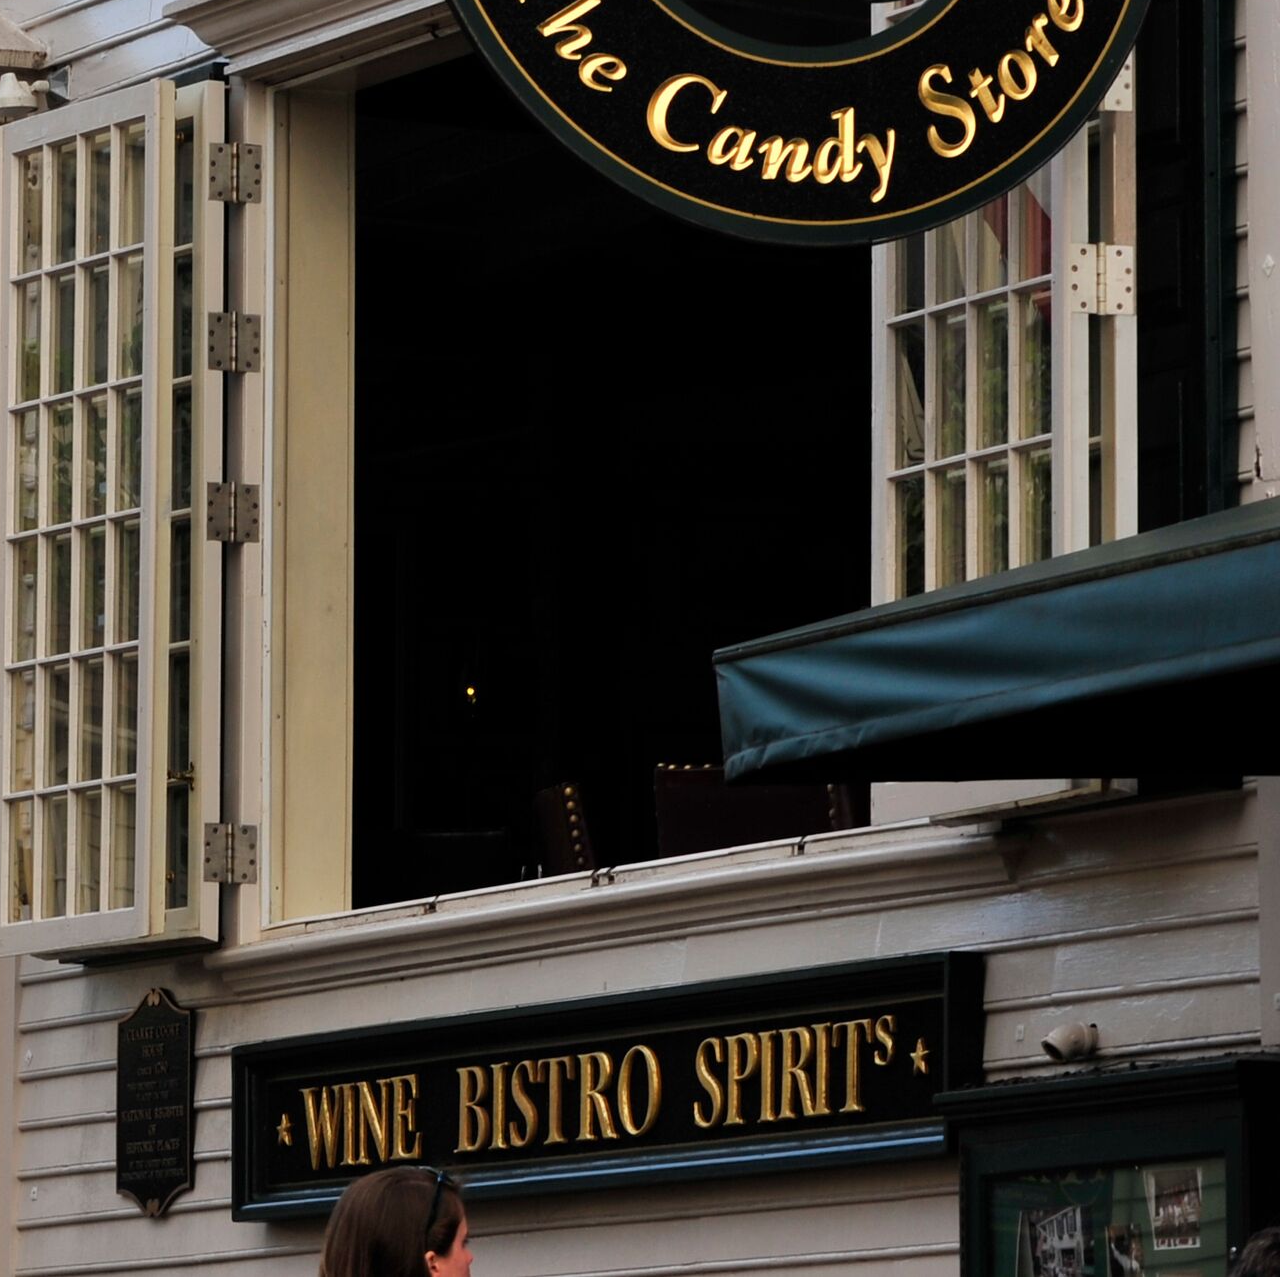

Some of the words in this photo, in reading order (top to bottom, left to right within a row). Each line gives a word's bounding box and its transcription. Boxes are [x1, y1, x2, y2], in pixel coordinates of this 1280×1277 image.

[646, 73, 896, 204] Candy
[300, 1073, 423, 1171] WINE
[453, 1045, 661, 1154] BISTRO
[693, 1014, 897, 1128] SPIRITS
